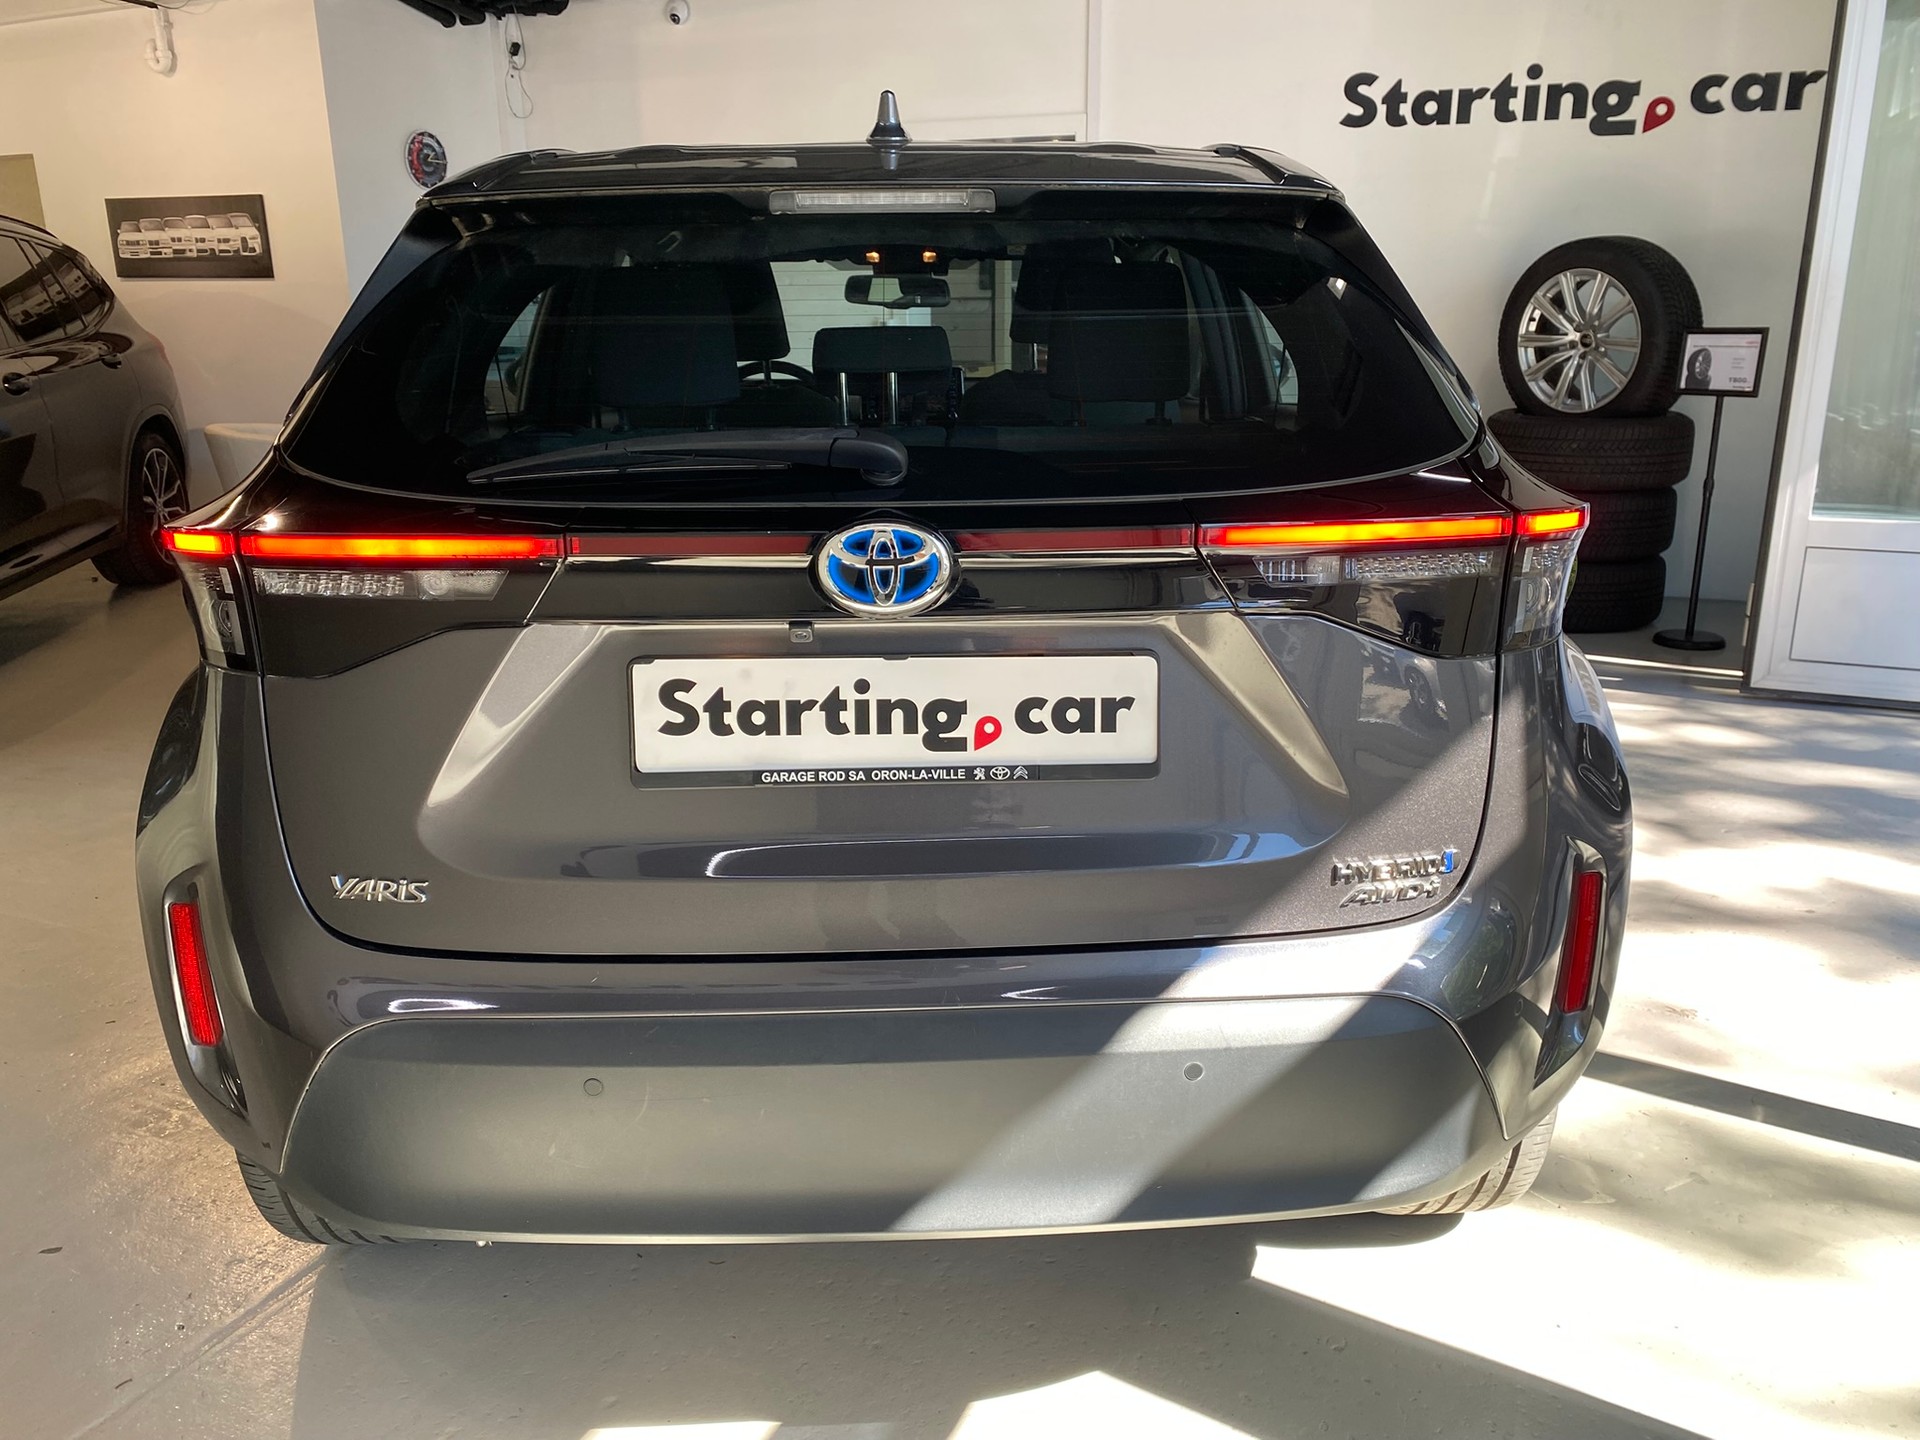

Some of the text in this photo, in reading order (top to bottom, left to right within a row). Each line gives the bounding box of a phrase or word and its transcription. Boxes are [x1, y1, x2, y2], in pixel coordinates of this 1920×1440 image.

[1339, 63, 1828, 136] Starting car
[656, 677, 1136, 752] Starting car
[761, 768, 967, 783] GARAGE ROD SA ORON-LA-VILLE
[1330, 855, 1442, 886] HYBRID
